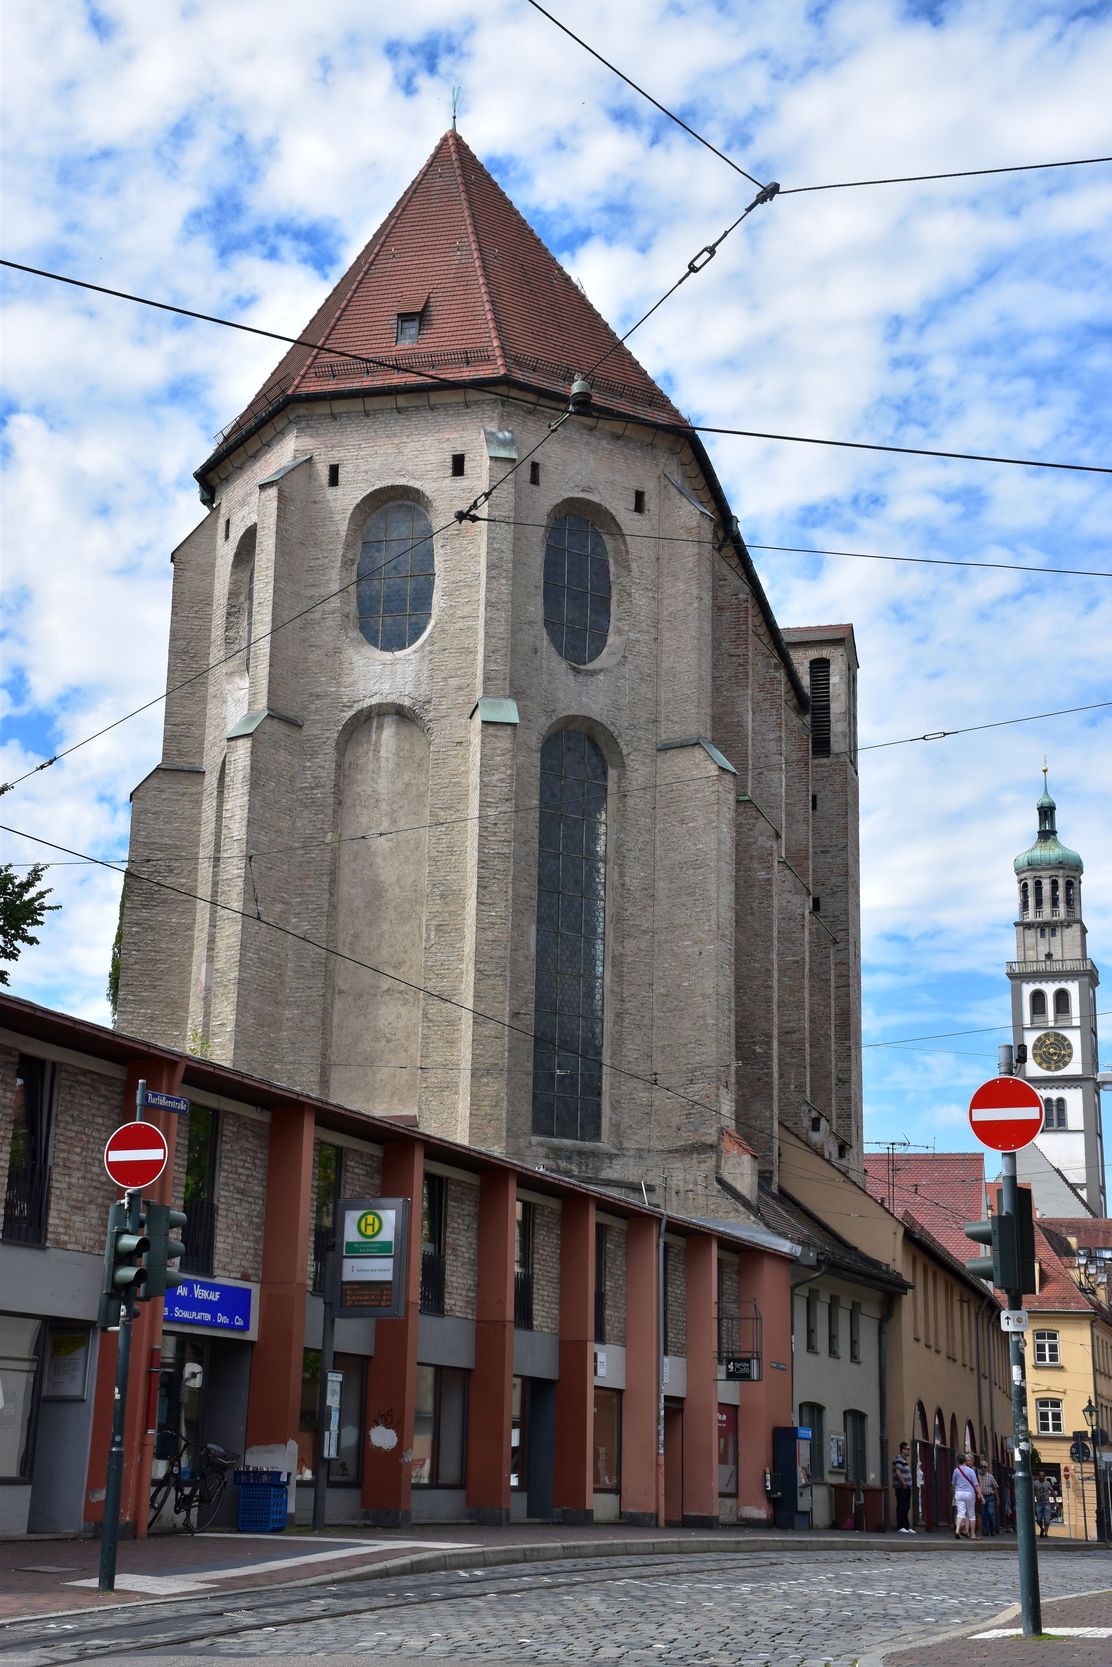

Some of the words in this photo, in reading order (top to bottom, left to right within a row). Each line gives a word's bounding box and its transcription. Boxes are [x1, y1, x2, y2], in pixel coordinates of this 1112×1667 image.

[147, 1093, 187, 1111] Barfüßerstraße
[364, 1216, 375, 1233] H
[193, 1283, 221, 1301] VERKAUF
[174, 1306, 211, 1322] SCHALLPLATTEN
